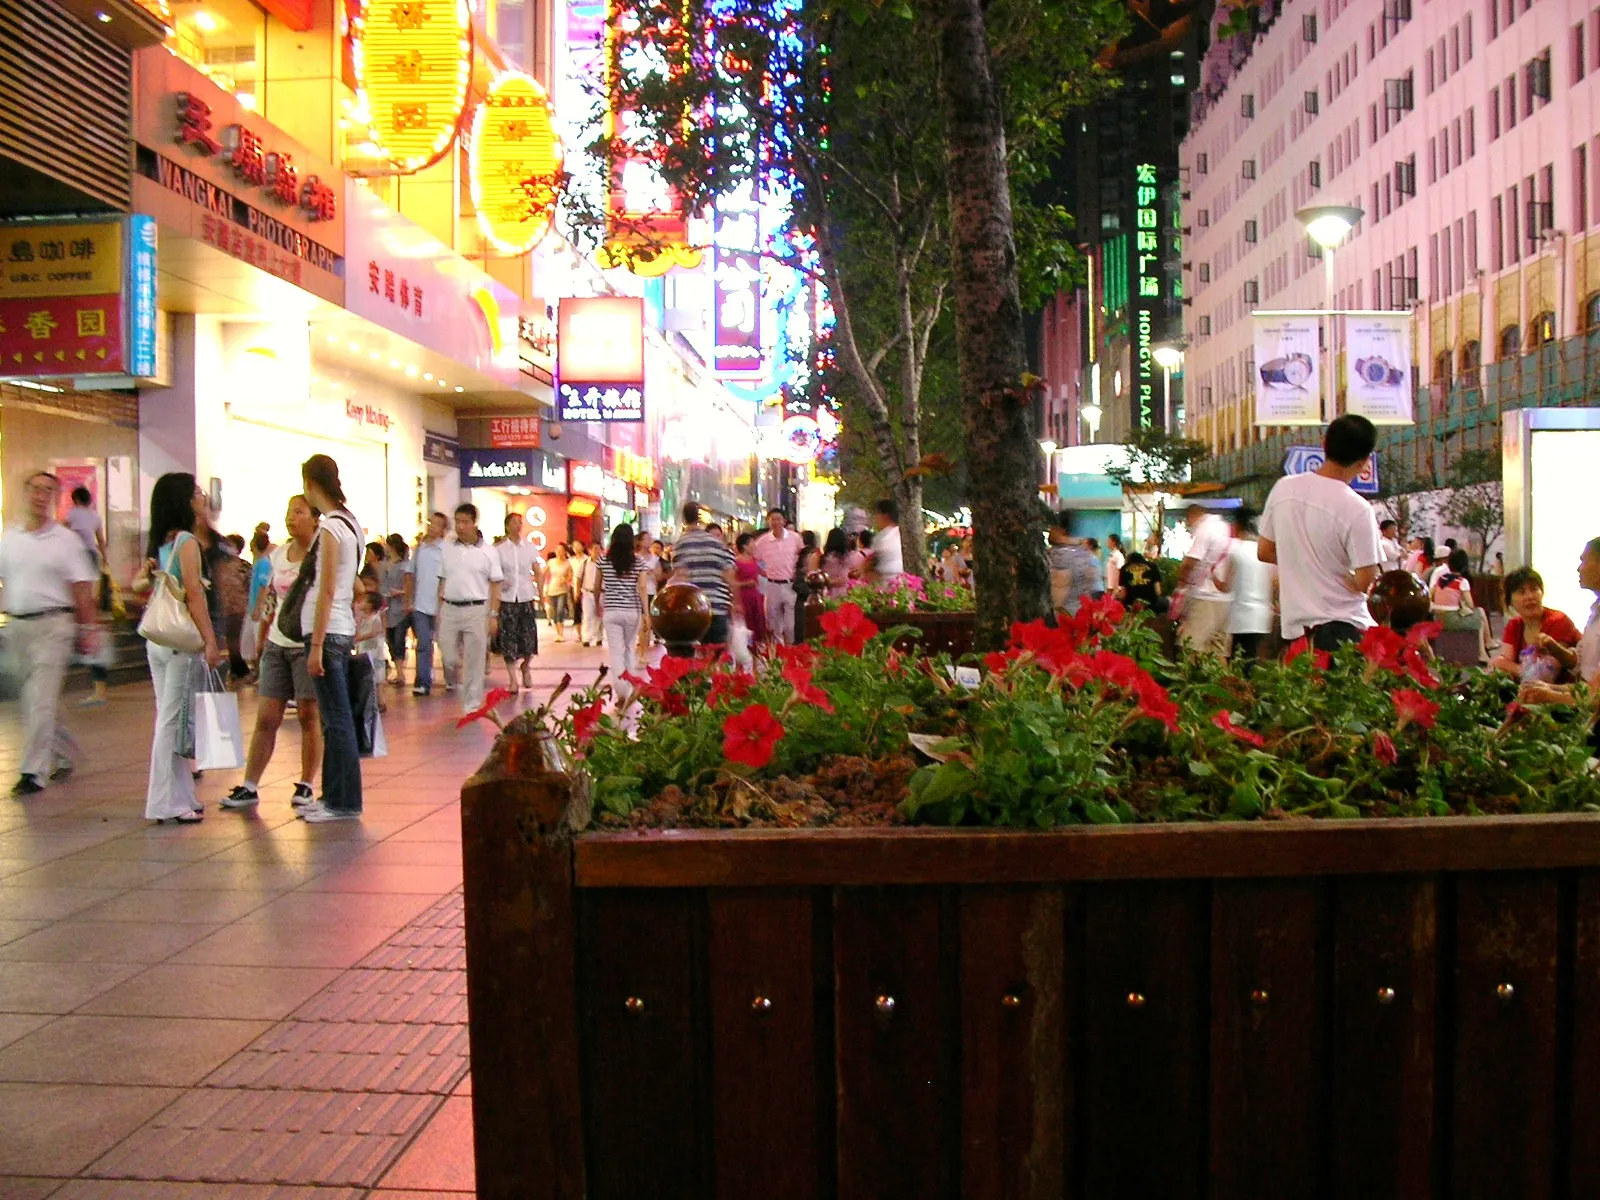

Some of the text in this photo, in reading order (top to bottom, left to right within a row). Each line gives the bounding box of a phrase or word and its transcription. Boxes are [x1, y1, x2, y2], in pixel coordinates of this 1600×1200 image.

[156, 153, 234, 221] WANGKAI
[248, 206, 335, 274] PHOTOGRAPH
[1137, 163, 1159, 297] 宏伊国际广场
[0, 310, 106, 340] 香园
[1139, 310, 1152, 430] HONGYI PLAZ
